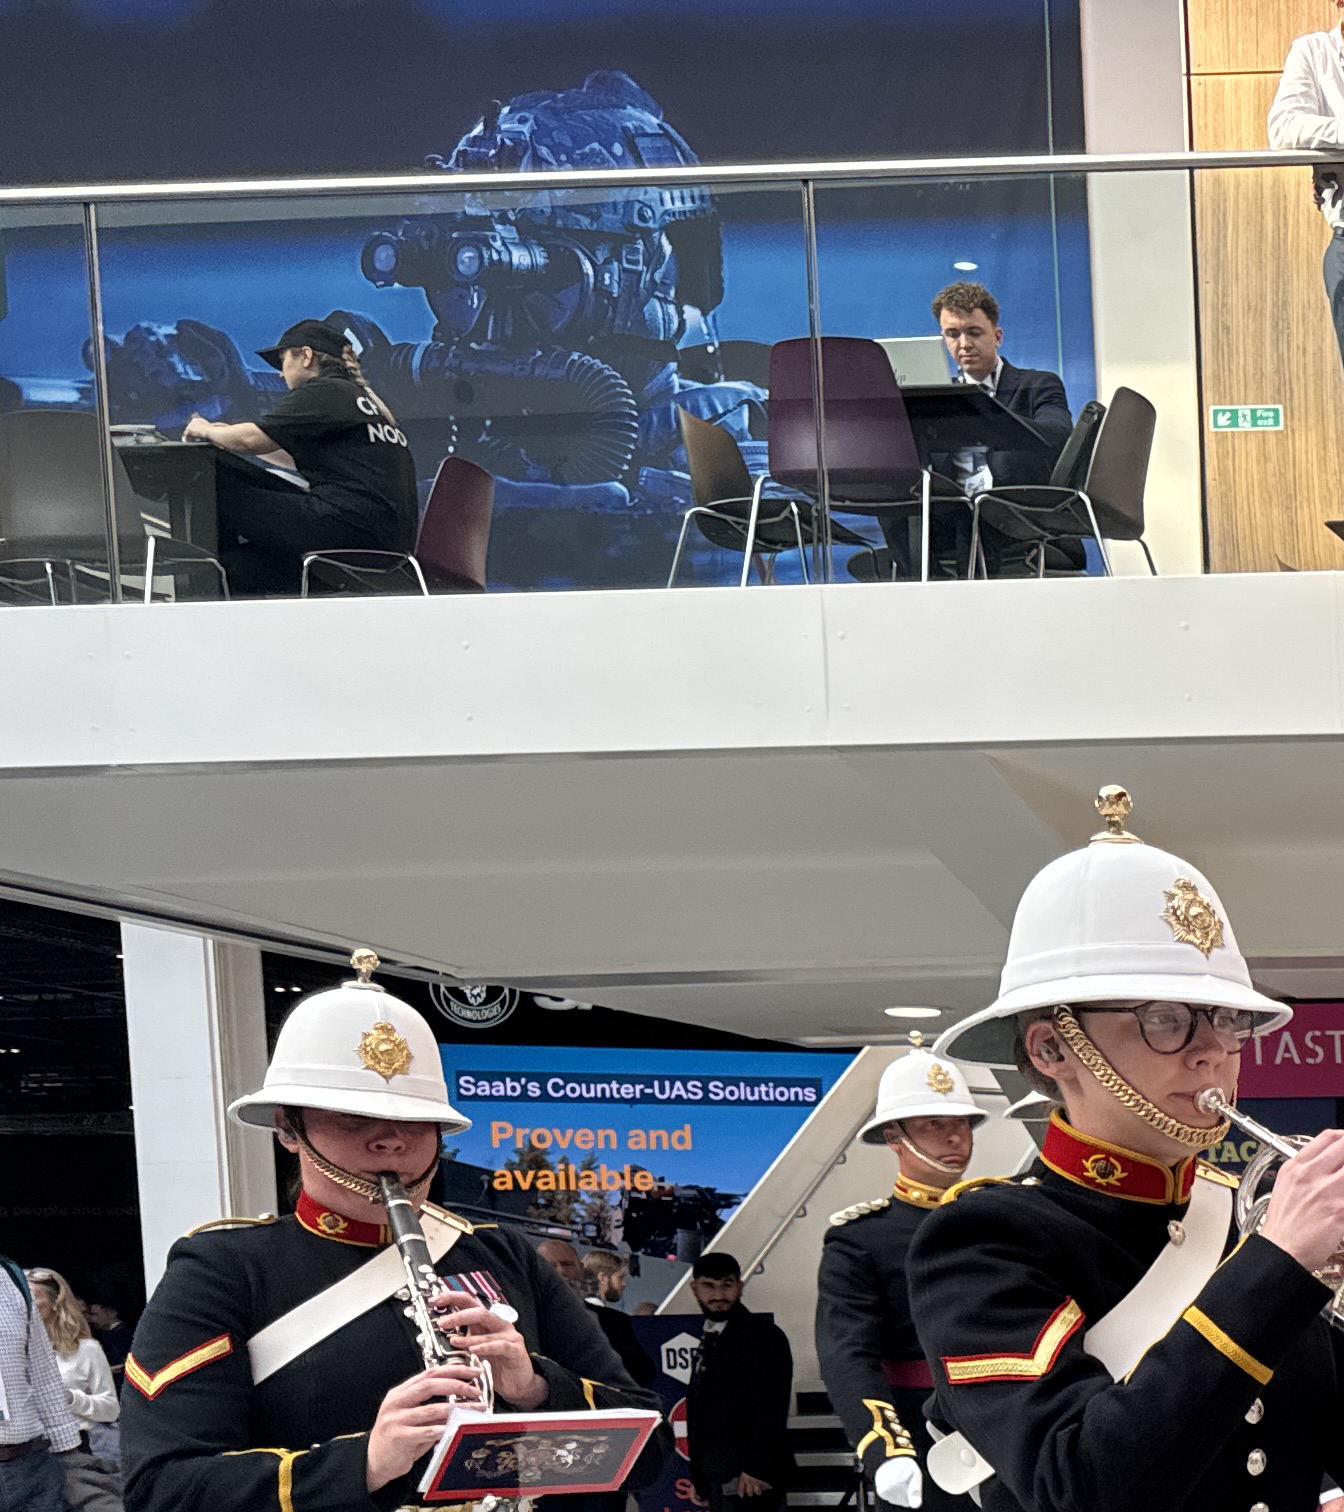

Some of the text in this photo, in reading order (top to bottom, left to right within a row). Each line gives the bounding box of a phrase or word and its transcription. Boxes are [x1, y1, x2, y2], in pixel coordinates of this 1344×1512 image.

[1256, 409, 1275, 418] Fire
[1256, 417, 1275, 426] exit
[449, 1000, 503, 1021] TECHNOLOGIES
[458, 1075, 818, 1103] Saab's Counter-UAS Solutions
[490, 1121, 693, 1151] Proven and
[492, 1164, 655, 1192] available
